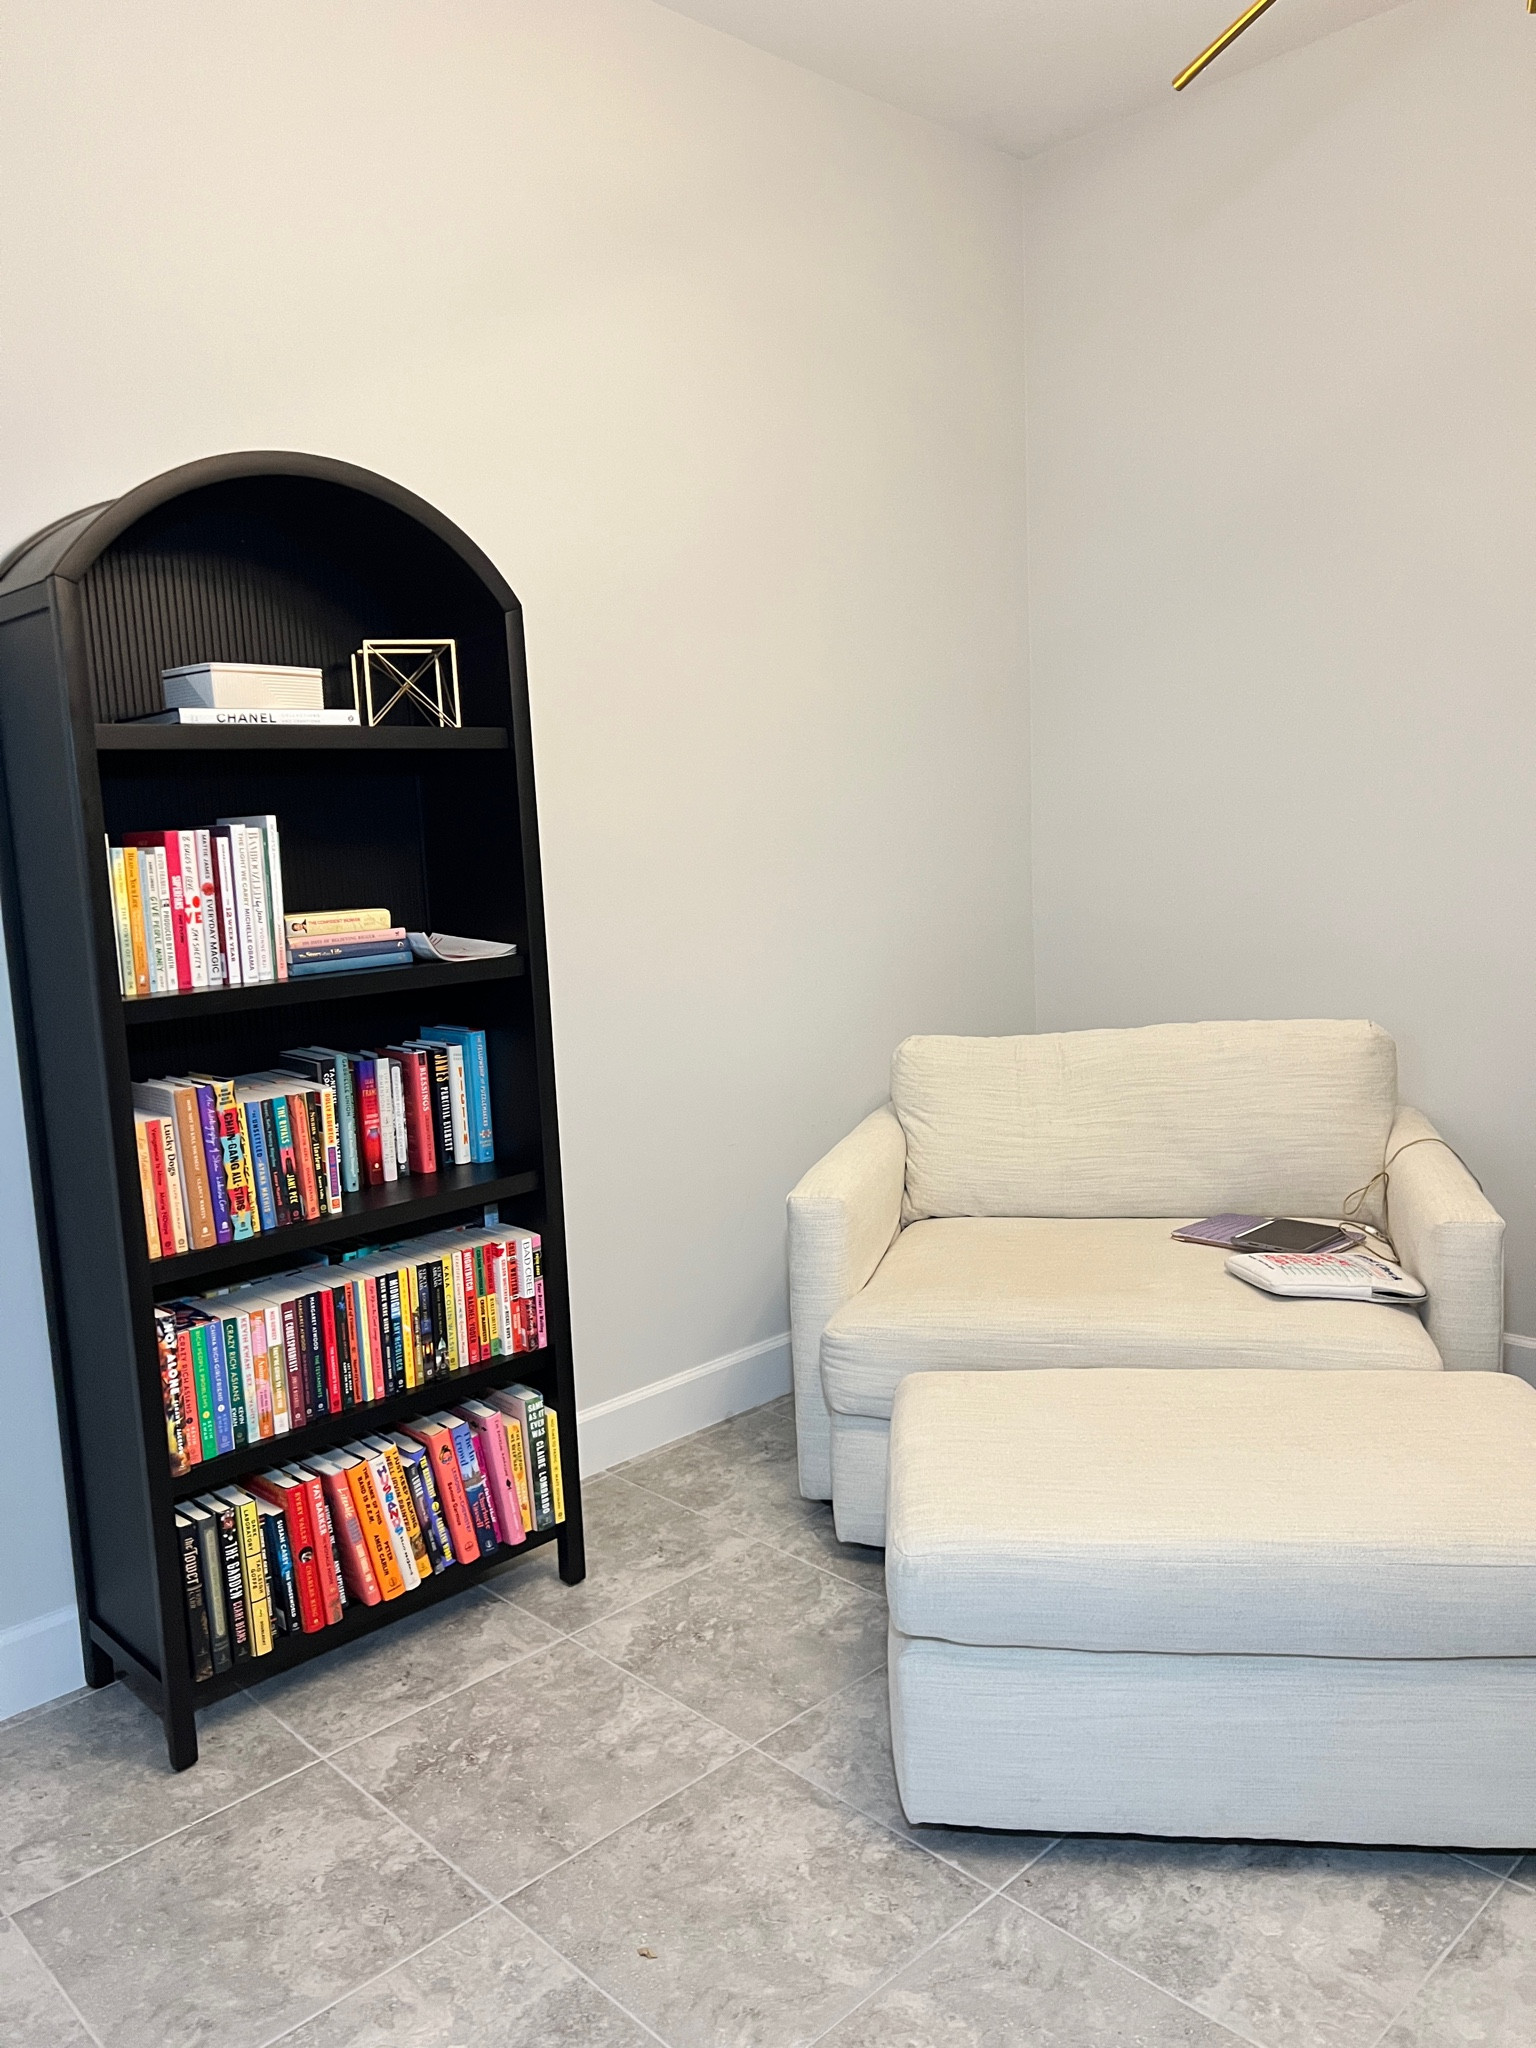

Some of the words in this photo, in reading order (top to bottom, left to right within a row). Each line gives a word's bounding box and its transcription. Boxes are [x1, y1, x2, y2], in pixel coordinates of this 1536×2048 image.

[217, 713, 277, 723] CHANEL
[183, 843, 191, 863] RULES
[185, 865, 192, 873] OF
[241, 870, 246, 880] WE
[171, 875, 183, 909] SUPERFANS
[150, 896, 158, 916] GIVE
[225, 907, 232, 917] 12
[152, 920, 161, 943] PEOPLE
[162, 910, 171, 941] PRODUCED
[206, 899, 216, 939] EVERYDAY
[244, 908, 252, 942] MICHELLE
[166, 942, 172, 950] BY
[210, 941, 219, 973] MAGIC
[247, 945, 255, 970] OBAMA
[155, 947, 163, 971] MONEY
[341, 1058, 349, 1092] GABRIELLE
[434, 1053, 449, 1082] JAMES
[419, 1067, 429, 1111] BLESSINGS
[276, 1106, 285, 1117] THE
[439, 1086, 451, 1118] PERCIVAL
[161, 1123, 174, 1151] Lucky
[278, 1119, 289, 1143] RIVALS
[326, 1113, 334, 1143] ALDERTON
[442, 1120, 453, 1151] EVERETT
[166, 1154, 177, 1176] Dogs
[223, 1112, 240, 1172] CHAIN-GANG
[232, 1171, 246, 1210] ALL-STARS
[286, 1173, 296, 1189] JANE
[289, 1191, 298, 1203] PEK
[523, 1241, 531, 1264] BAD
[463, 1251, 473, 1291] NIGHTBITCH
[525, 1267, 533, 1294] CREE
[389, 1279, 400, 1318] MIDNIGHT
[283, 1310, 292, 1320] THE
[161, 1323, 175, 1349] NOT
[225, 1324, 234, 1348] CRAZY
[240, 1318, 248, 1342] KEVIN
[242, 1345, 250, 1369] KWAN
[284, 1322, 298, 1372] CORRESPONDENTS
[209, 1325, 217, 1345] CHINA
[214, 1364, 223, 1401] GIRLFRIEND
[228, 1351, 237, 1369] RICH
[165, 1353, 181, 1394] ALONE
[181, 1364, 189, 1383] RICH
[314, 1365, 322, 1397] TESTAMENTS
[230, 1372, 240, 1401] ASIANS
[183, 1385, 191, 1414] ASIANS
[527, 1400, 544, 1413] SAME
[529, 1412, 538, 1421] AS
[530, 1420, 545, 1430] EVER
[463, 1431, 473, 1449] The
[531, 1429, 545, 1439] WAS
[454, 1435, 468, 1466] Crowd
[467, 1450, 476, 1461] In
[535, 1440, 546, 1468] CLAIRE
[294, 1492, 303, 1514] EVERY
[312, 1483, 321, 1499] PAT
[357, 1476, 366, 1494] BAND
[365, 1504, 374, 1523] R.E.M.
[366, 1481, 375, 1500] NAME
[375, 1465, 404, 1536] HUSBANDS
[385, 1455, 394, 1474] NELL
[391, 1477, 401, 1497] IRVIN
[397, 1499, 411, 1531] PAINTER
[393, 1455, 402, 1473] JUST
[398, 1475, 408, 1494] KEEP
[404, 1495, 418, 1528] TALKING
[450, 1467, 461, 1493] LESSONS
[459, 1500, 471, 1532] CHEMISTRY
[538, 1471, 551, 1513] LOMBARDO
[372, 1500, 377, 1508] OF
[447, 1482, 455, 1502] Bonnie
[452, 1504, 461, 1525] Garmus
[477, 1492, 491, 1529] Charlotte
[243, 1509, 252, 1550] LABORATORY
[298, 1517, 307, 1543] VALLEY
[315, 1502, 327, 1535] BARKER
[374, 1510, 382, 1525] THIS
[183, 1537, 194, 1549] the
[275, 1519, 285, 1542] SUSAN
[224, 1541, 238, 1561] THE
[279, 1544, 289, 1565] CASEY
[373, 1534, 382, 1552] AMES
[379, 1553, 389, 1575] CARLIN
[383, 1541, 392, 1561] PETER
[183, 1547, 201, 1584] Tower
[226, 1561, 243, 1599] GARDEN
[305, 1565, 315, 1596] CHARLES
[232, 1600, 243, 1620] CLARE
[285, 1581, 297, 1617] UNDERWORLD
[309, 1598, 317, 1616] KING
[234, 1621, 246, 1643] BEAMS
